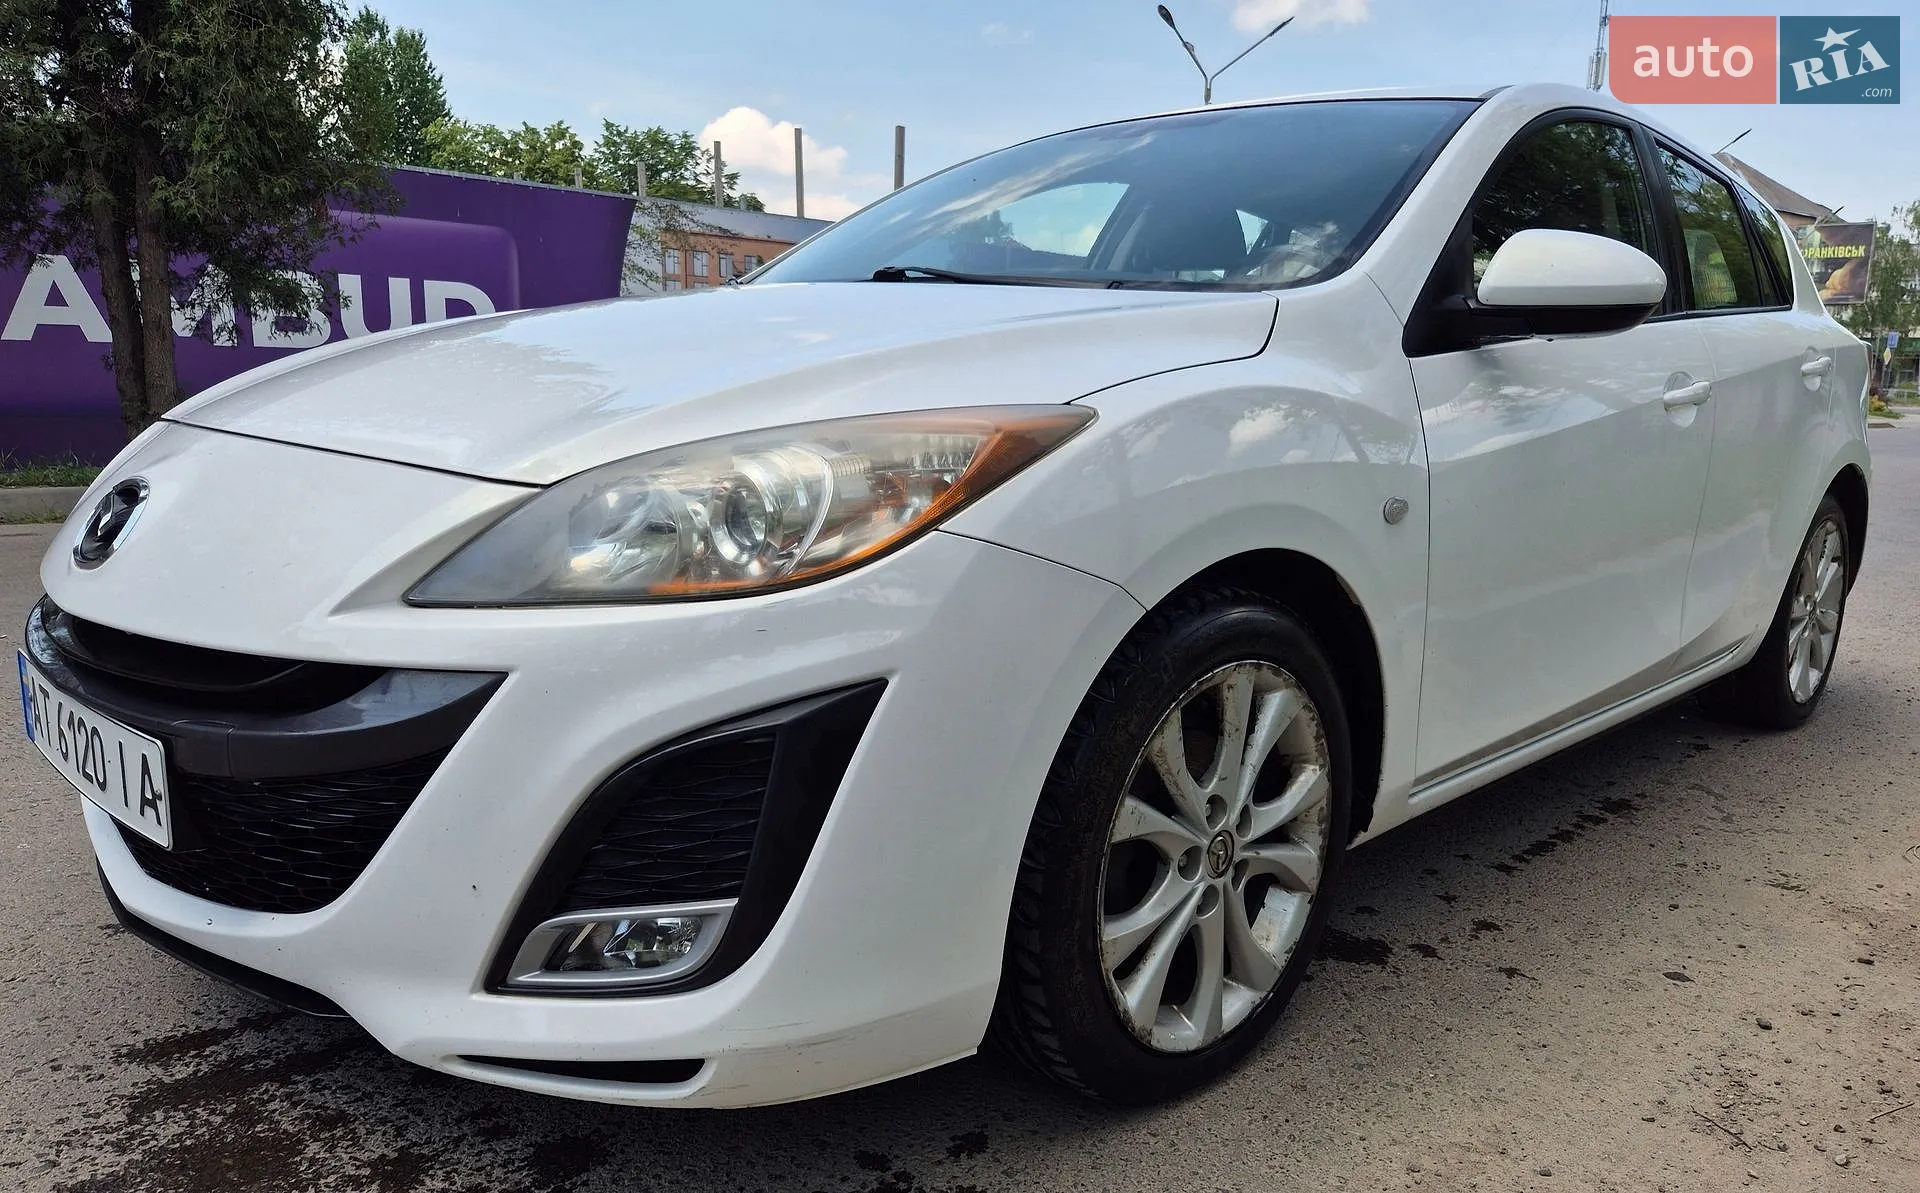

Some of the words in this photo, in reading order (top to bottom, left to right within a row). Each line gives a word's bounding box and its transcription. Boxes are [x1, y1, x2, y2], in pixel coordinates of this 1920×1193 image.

[29, 676, 51, 747] AT
[57, 701, 107, 792] 6120
[118, 740, 163, 826] IA
